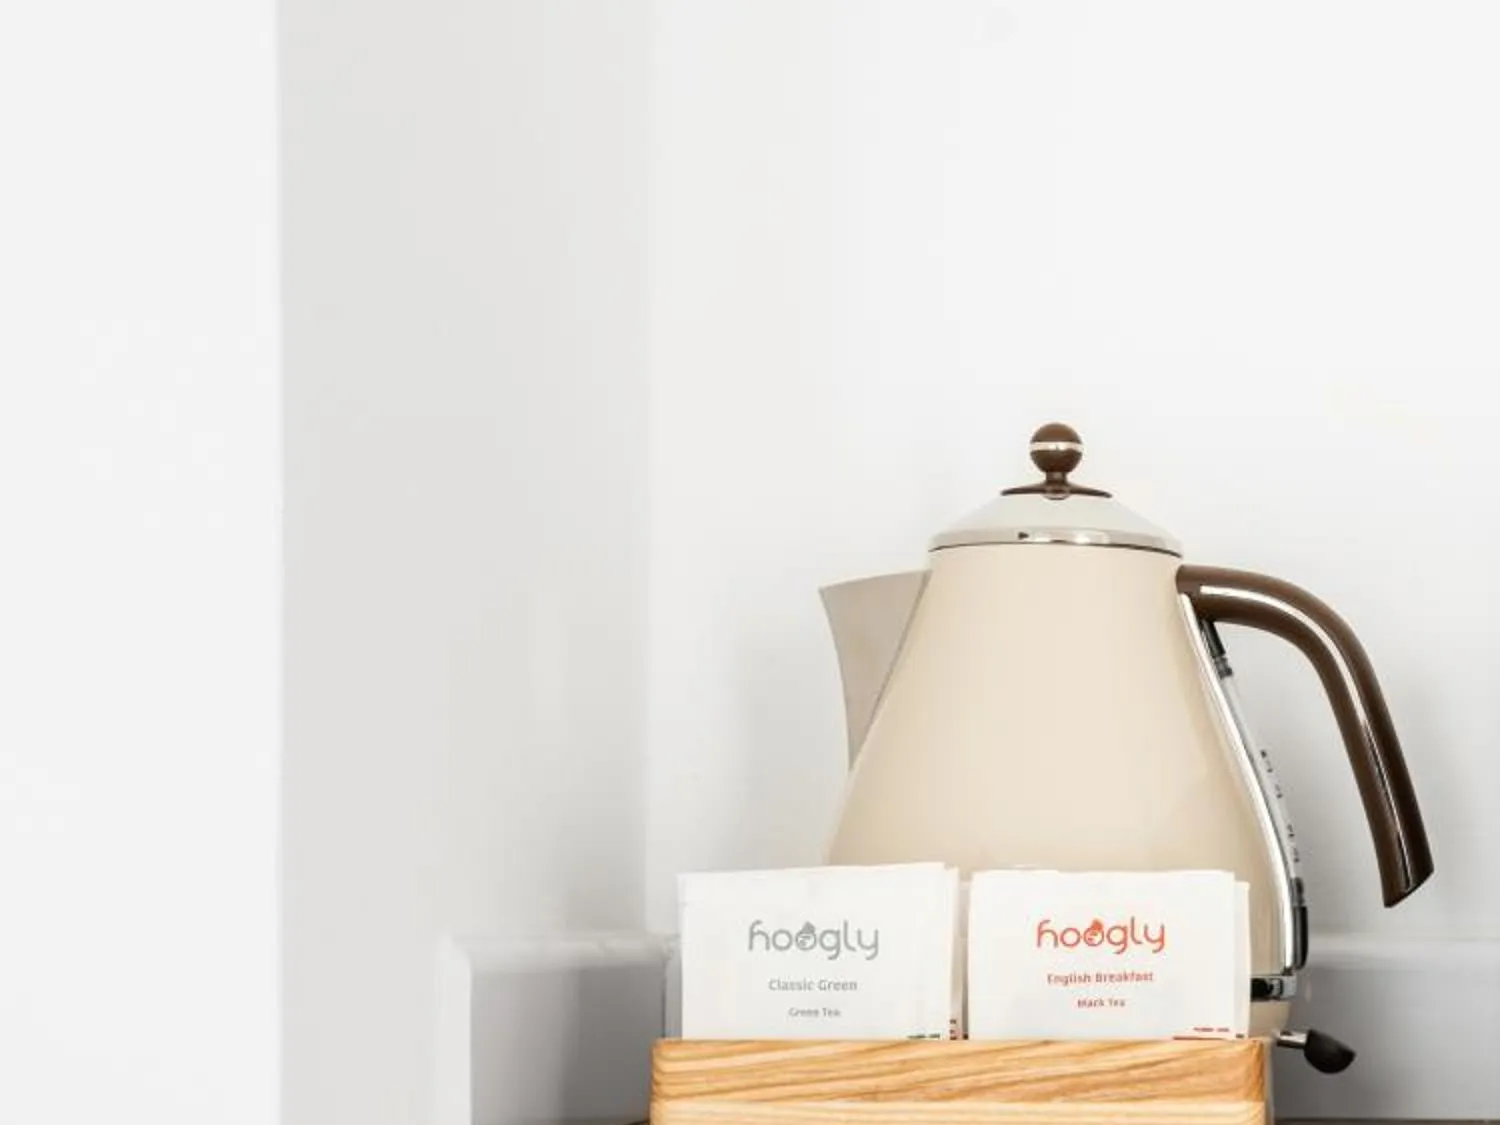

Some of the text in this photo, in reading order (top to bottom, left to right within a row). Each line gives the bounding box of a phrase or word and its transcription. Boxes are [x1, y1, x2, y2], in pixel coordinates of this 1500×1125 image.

[748, 918, 880, 961] hoogly
[1036, 915, 1166, 955] hoogly
[768, 978, 858, 992] Classic Green
[1047, 971, 1154, 986] English Breakfast
